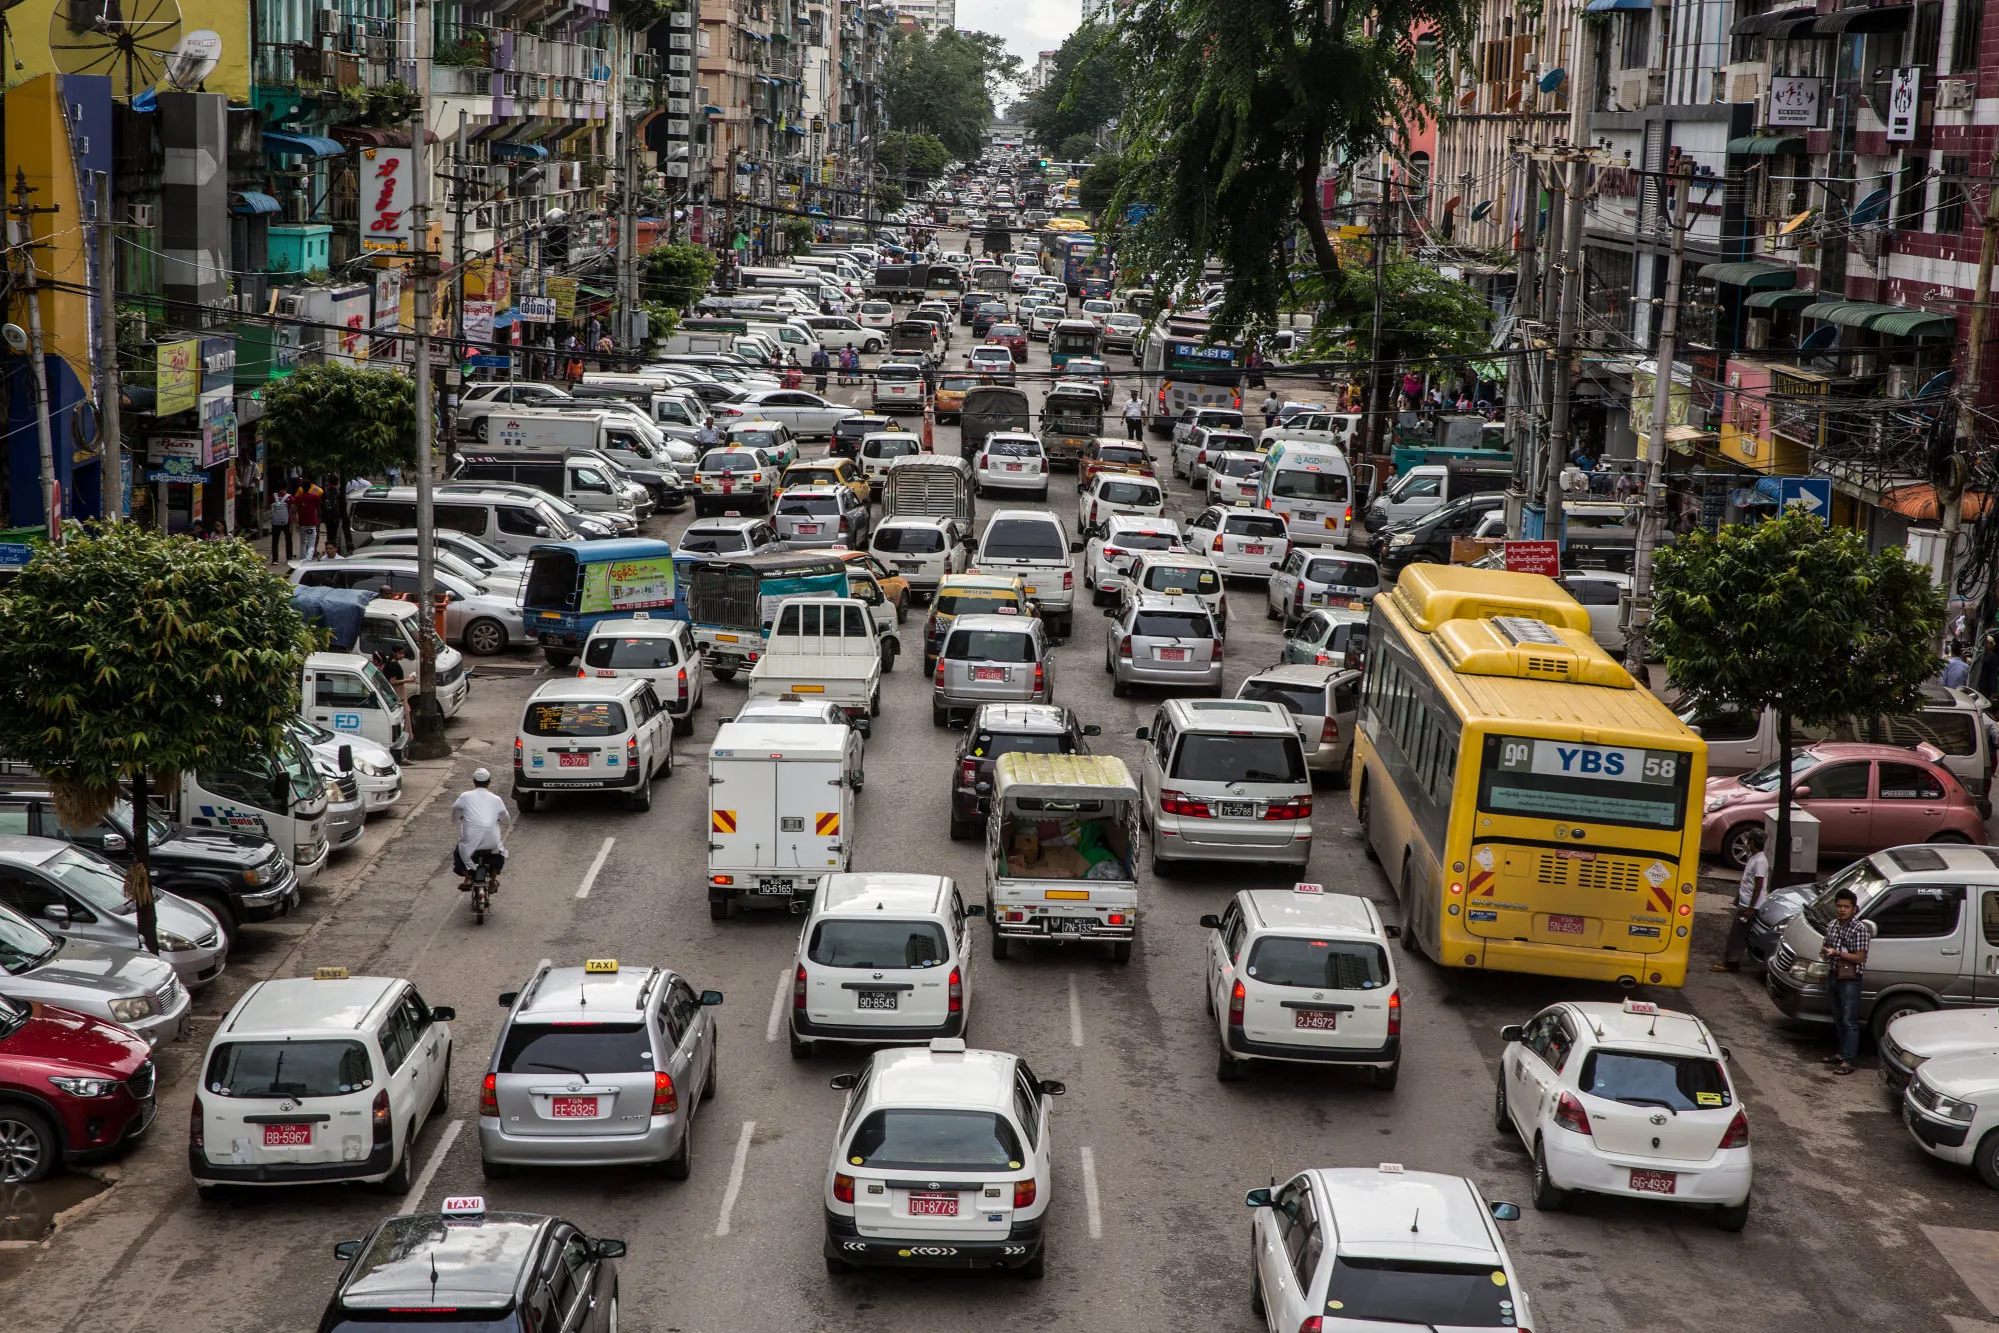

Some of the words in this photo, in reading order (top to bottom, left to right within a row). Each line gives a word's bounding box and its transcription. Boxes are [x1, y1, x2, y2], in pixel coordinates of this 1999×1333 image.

[672, 14, 686, 134] CHERRY
[561, 756, 588, 766] CC-3776
[1556, 747, 1625, 776] YBS
[1643, 757, 1676, 778] 58
[1223, 806, 1252, 816] 7E-5786
[1299, 884, 1320, 893] TAXI
[1064, 923, 1096, 933] 7N-1337
[1549, 921, 1583, 934] 5N-4520
[590, 962, 613, 970] TAXI
[320, 970, 342, 978] TAXI
[859, 998, 896, 1009] 9D-8543
[1632, 1004, 1654, 1013] TAXI
[1297, 1017, 1334, 1029] 2J-4972
[554, 1105, 596, 1117] EE-9325
[265, 1131, 308, 1144] BB-5967
[1631, 1176, 1673, 1192] 6G-4937
[447, 1198, 480, 1210] TAXI
[911, 1201, 955, 1214] DD-8778
